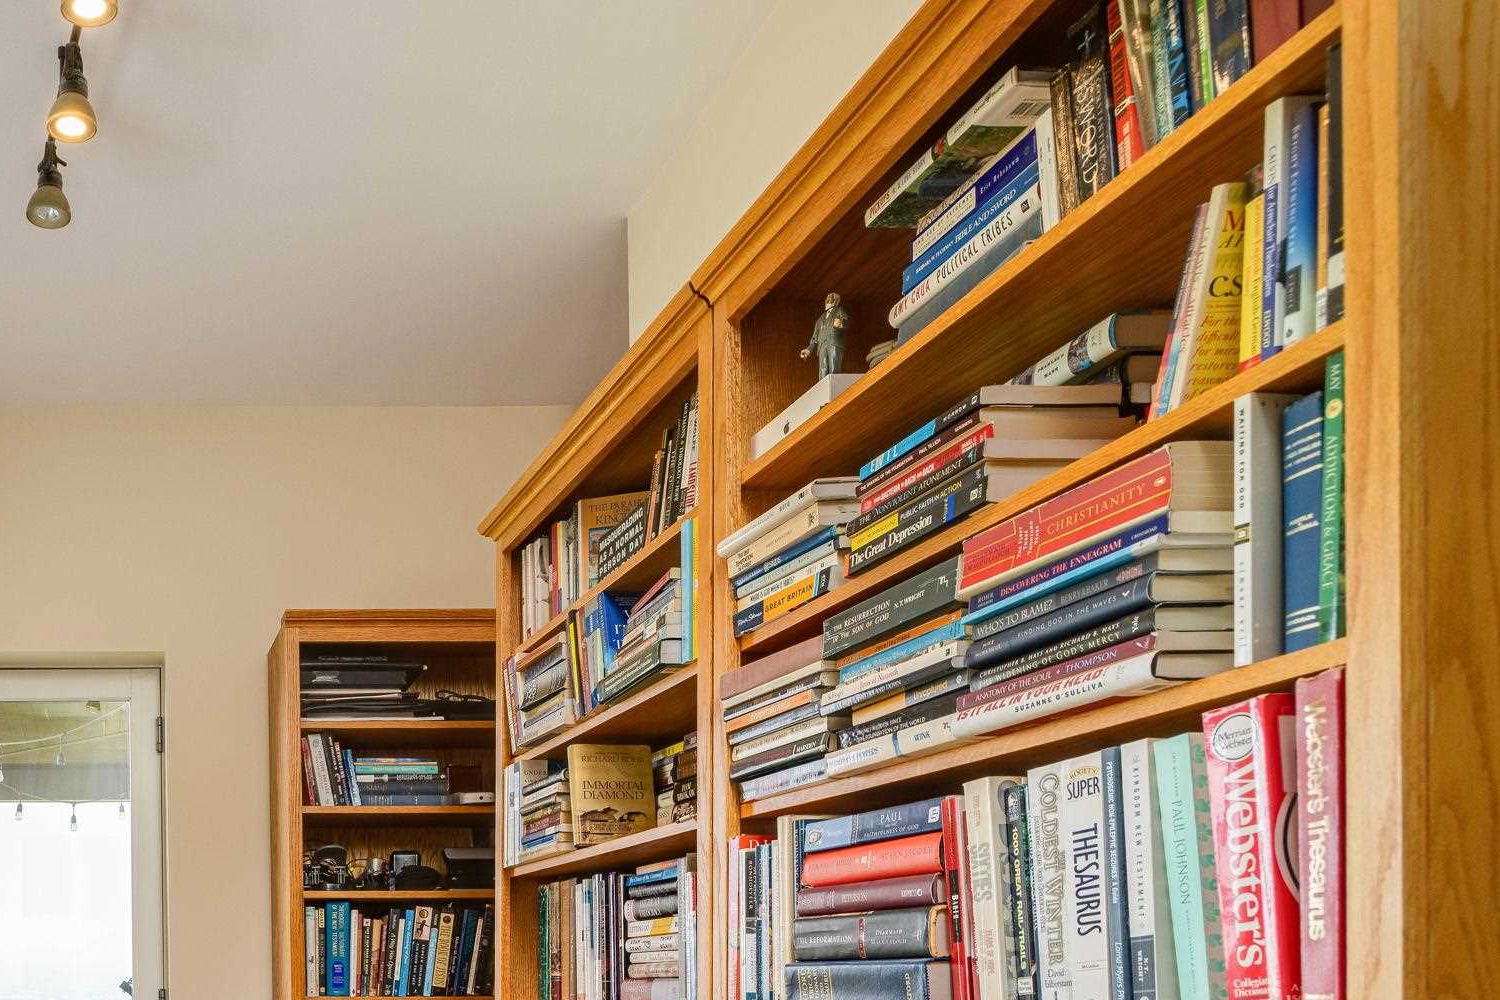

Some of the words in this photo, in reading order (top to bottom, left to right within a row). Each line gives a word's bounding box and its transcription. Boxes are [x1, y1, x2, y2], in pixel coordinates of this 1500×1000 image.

[936, 244, 979, 284] POLITICAL
[981, 211, 1014, 245] TRIBES
[1329, 364, 1340, 390] MAY
[1322, 435, 1339, 522] ADDICTION
[599, 507, 644, 549] MASQUERADING
[1048, 483, 1142, 535] CHRISTIANITY
[615, 524, 644, 553] NORMAL
[850, 551, 861, 566] The
[866, 536, 884, 558] Great
[890, 511, 930, 546] Depression
[1323, 526, 1333, 537] &
[599, 553, 626, 577] PERSON
[629, 533, 644, 552] DAY
[1001, 569, 1048, 597] DISCOVERING
[1053, 561, 1064, 575] THE
[1071, 536, 1122, 568] ENNEAGRAM
[1320, 540, 1333, 590] GRACE
[766, 596, 785, 612] GREAT
[789, 583, 812, 601] BRITAIN
[844, 599, 889, 627] RESURRECTION
[978, 616, 1004, 639] WHO'S
[1008, 611, 1017, 625] TO
[1023, 597, 1051, 620] BLAME?
[1017, 623, 1044, 639] FINDING
[1048, 616, 1061, 627] GOD
[1066, 612, 1073, 620] IN
[1077, 605, 1089, 616] THE
[1094, 595, 1115, 609] WAVES
[997, 660, 1037, 681] WIDENING
[1042, 653, 1051, 664] OF
[1056, 643, 1083, 659] GOD'S
[1088, 630, 1119, 649] MERCY
[1066, 649, 1117, 673] THOMPSON
[975, 685, 1005, 702] ANATOMY
[1008, 682, 1015, 691] OF
[1018, 678, 1027, 689] THE
[1029, 669, 1051, 685] SOUL
[1304, 704, 1328, 814] Webster's
[583, 780, 644, 790] IMMORTAL
[583, 791, 644, 800] DIAMOND
[1067, 777, 1100, 801] SUPER
[1132, 767, 1140, 817] KINGDOM
[881, 809, 900, 824] PAUL
[1035, 773, 1064, 872] COLDEST
[1170, 799, 1183, 835] PAUL
[1010, 826, 1019, 855] 1000
[1012, 859, 1022, 897] GREAT
[1068, 826, 1105, 937] THESAURUS
[1173, 837, 1191, 906] JOHNSON
[1225, 758, 1264, 968] Webster's
[1306, 816, 1330, 940] Thesaurus
[1135, 853, 1145, 918] TESTAMENT
[810, 930, 852, 947] REFORMATION
[1014, 901, 1027, 970] RAIL-TRAILS
[1040, 875, 1069, 966] WINTER
[1113, 942, 1123, 963] Lorna
[1136, 950, 1144, 982] WRIGHT
[1114, 966, 1125, 988] Myers
